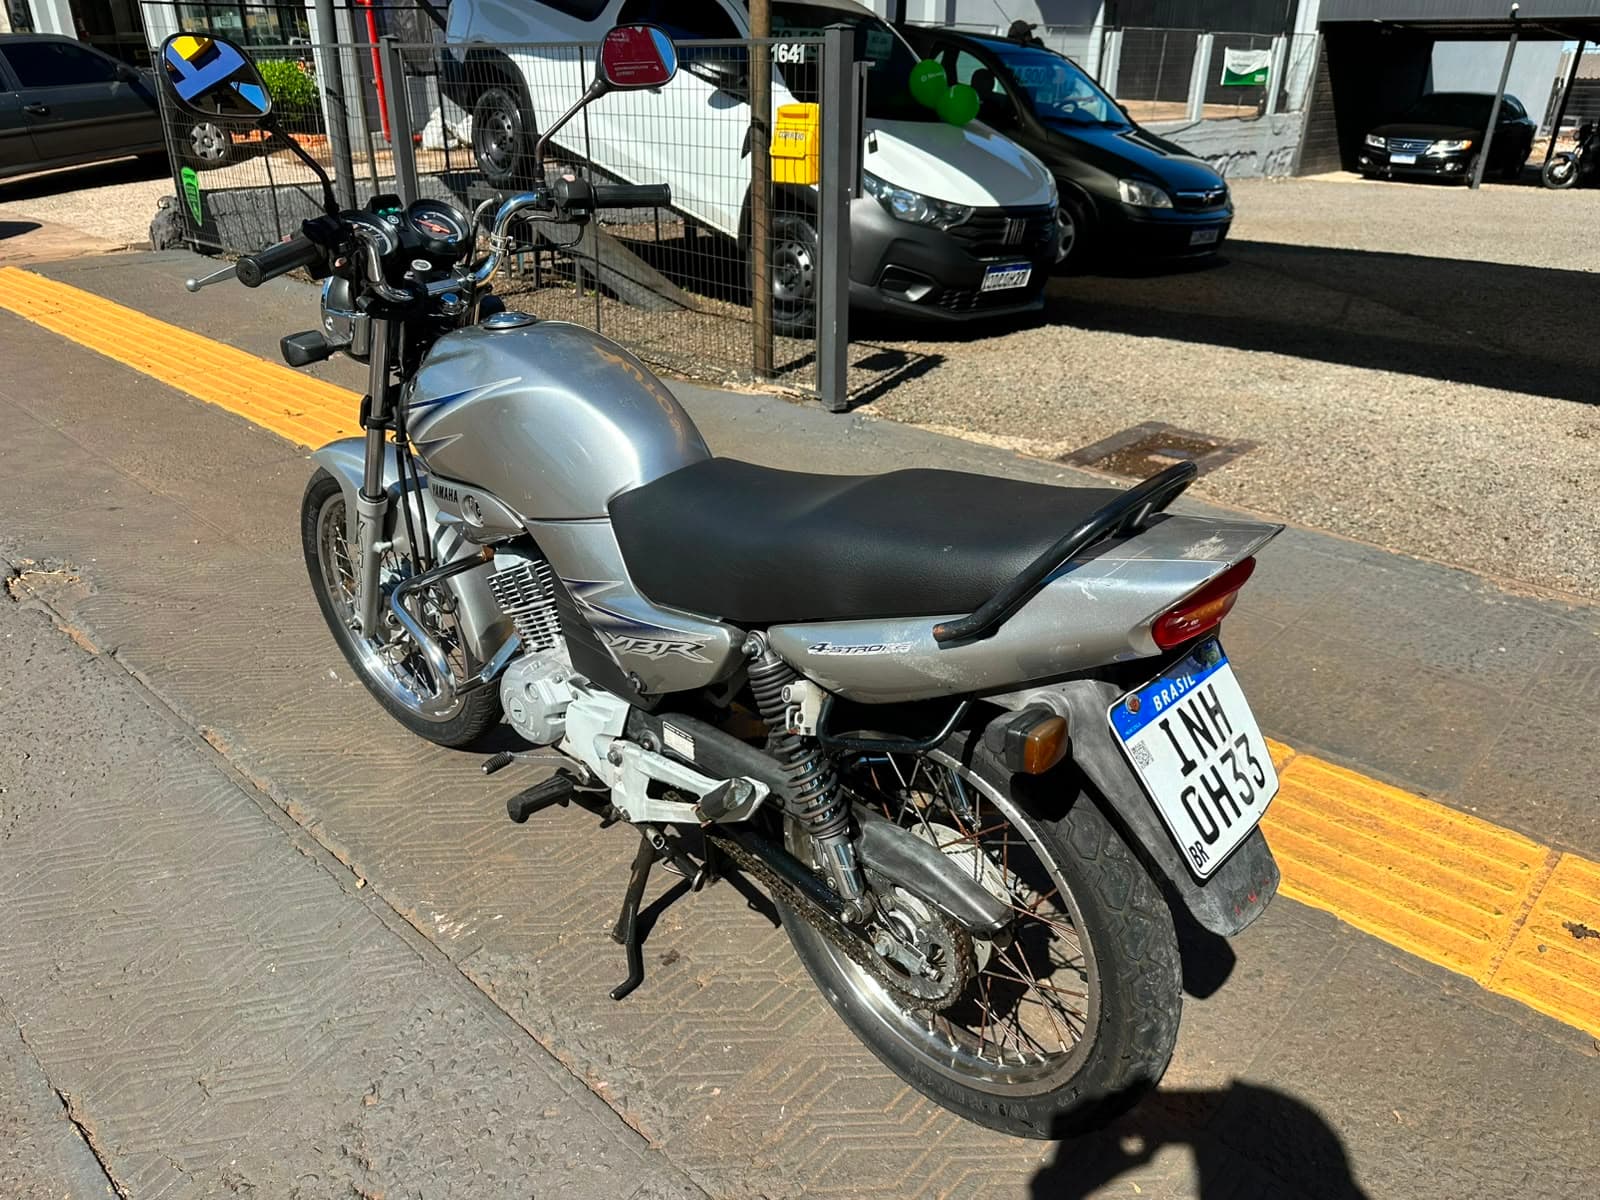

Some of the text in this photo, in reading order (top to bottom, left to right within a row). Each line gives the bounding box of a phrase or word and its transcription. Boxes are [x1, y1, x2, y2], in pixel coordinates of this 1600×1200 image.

[770, 43, 806, 64] 1641
[431, 483, 459, 503] YAMAHA
[605, 631, 714, 664] YBR
[1152, 674, 1196, 712] BRASIL
[1158, 683, 1233, 777] INH
[1188, 839, 1211, 869] BR
